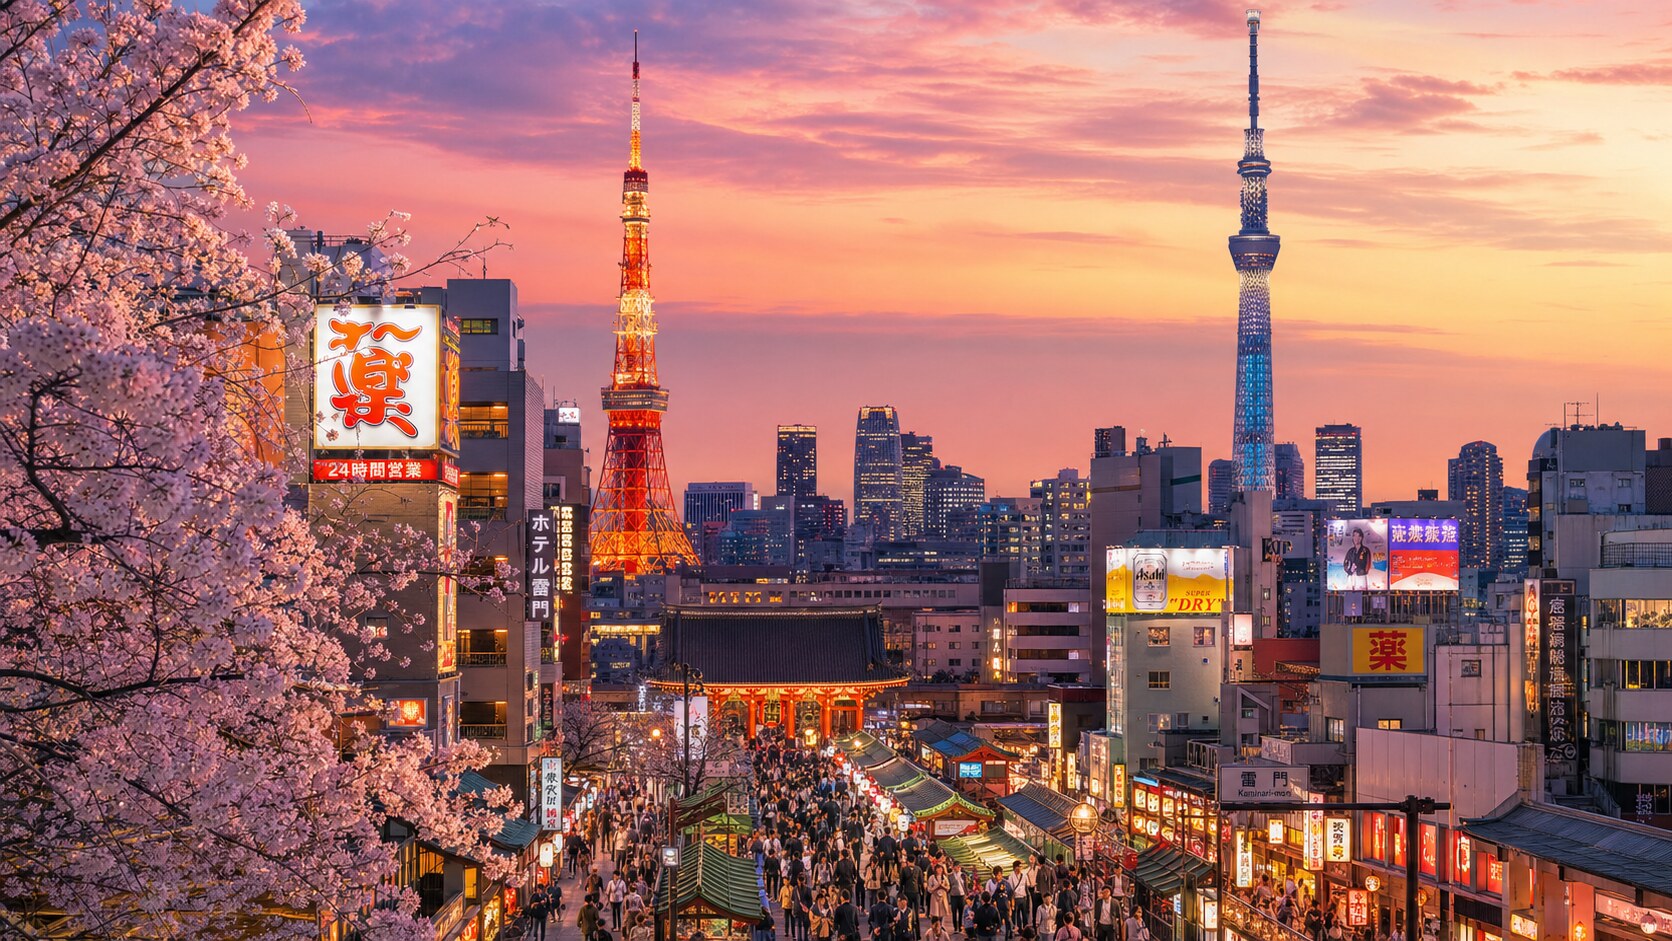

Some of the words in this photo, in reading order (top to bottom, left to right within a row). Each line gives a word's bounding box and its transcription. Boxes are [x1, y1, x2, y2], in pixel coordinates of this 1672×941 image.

[328, 461, 422, 479] 24時間営業
[531, 514, 550, 619] ホテル雷門
[1136, 567, 1165, 580] Asahi
[1368, 630, 1408, 671] 薬
[1241, 771, 1288, 787] 雷門
